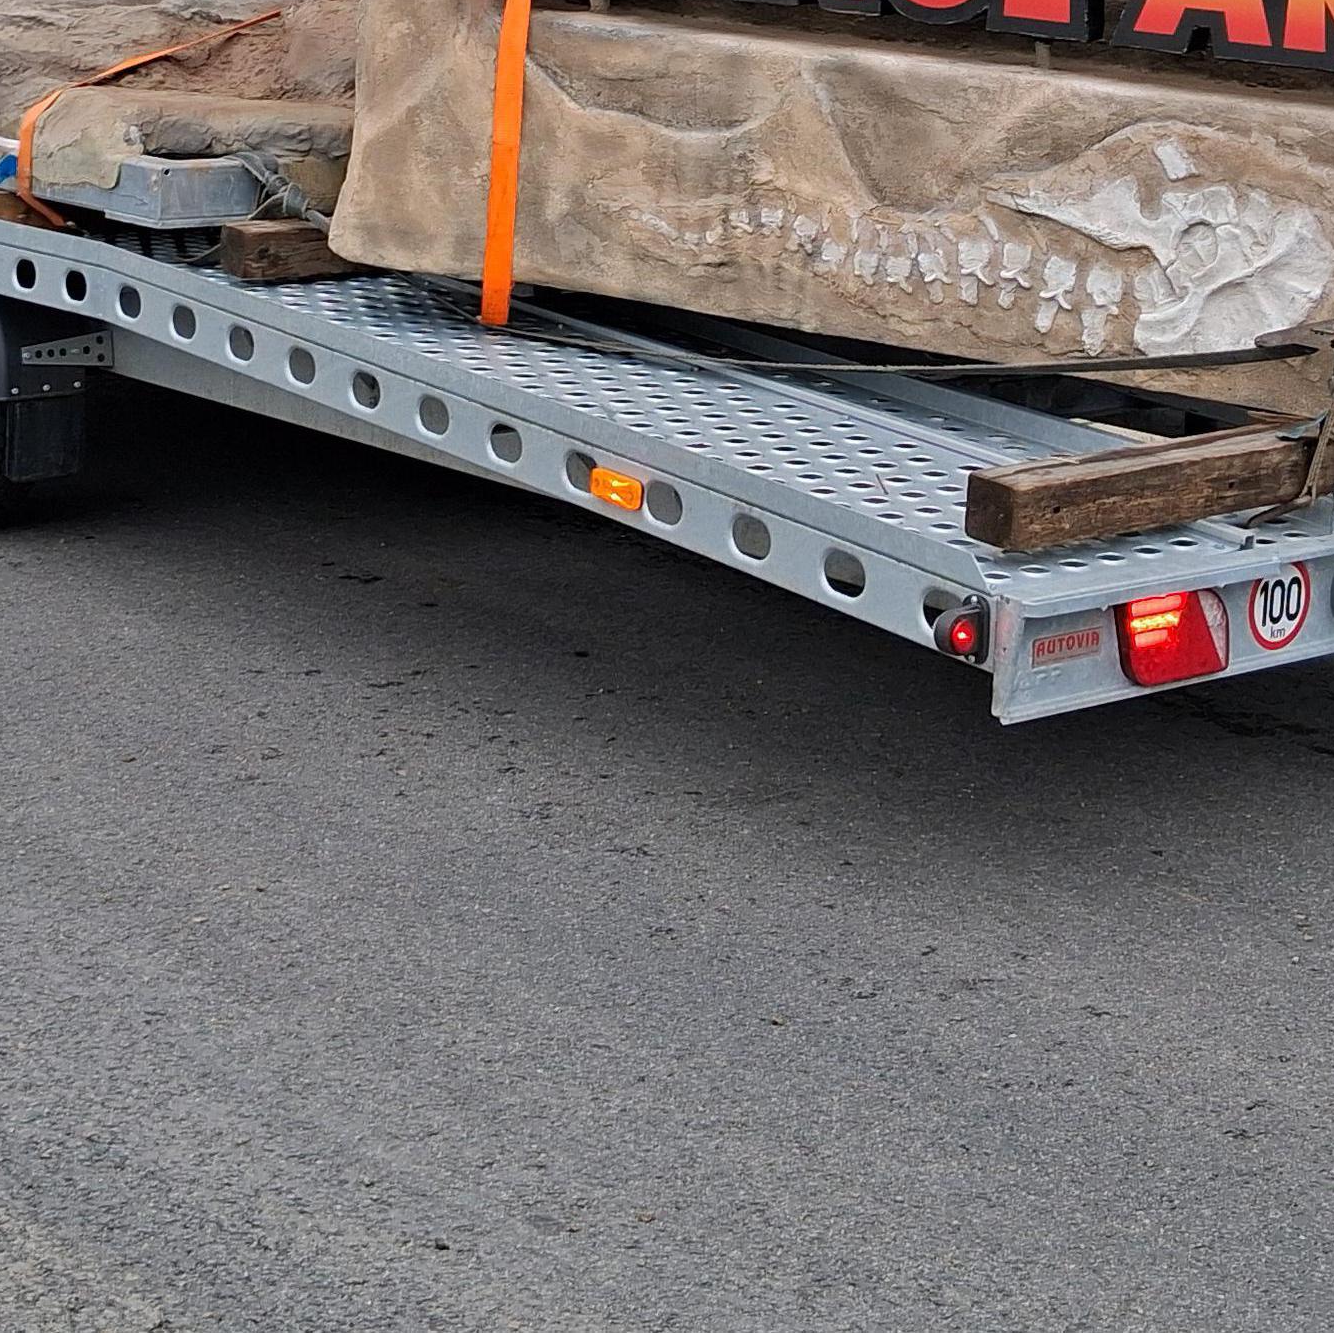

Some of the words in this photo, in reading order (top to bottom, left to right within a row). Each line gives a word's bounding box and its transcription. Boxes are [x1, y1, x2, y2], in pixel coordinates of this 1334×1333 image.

[1259, 575, 1303, 628] 100
[1035, 630, 1101, 658] AUTOVIA
[1270, 626, 1286, 639] km
